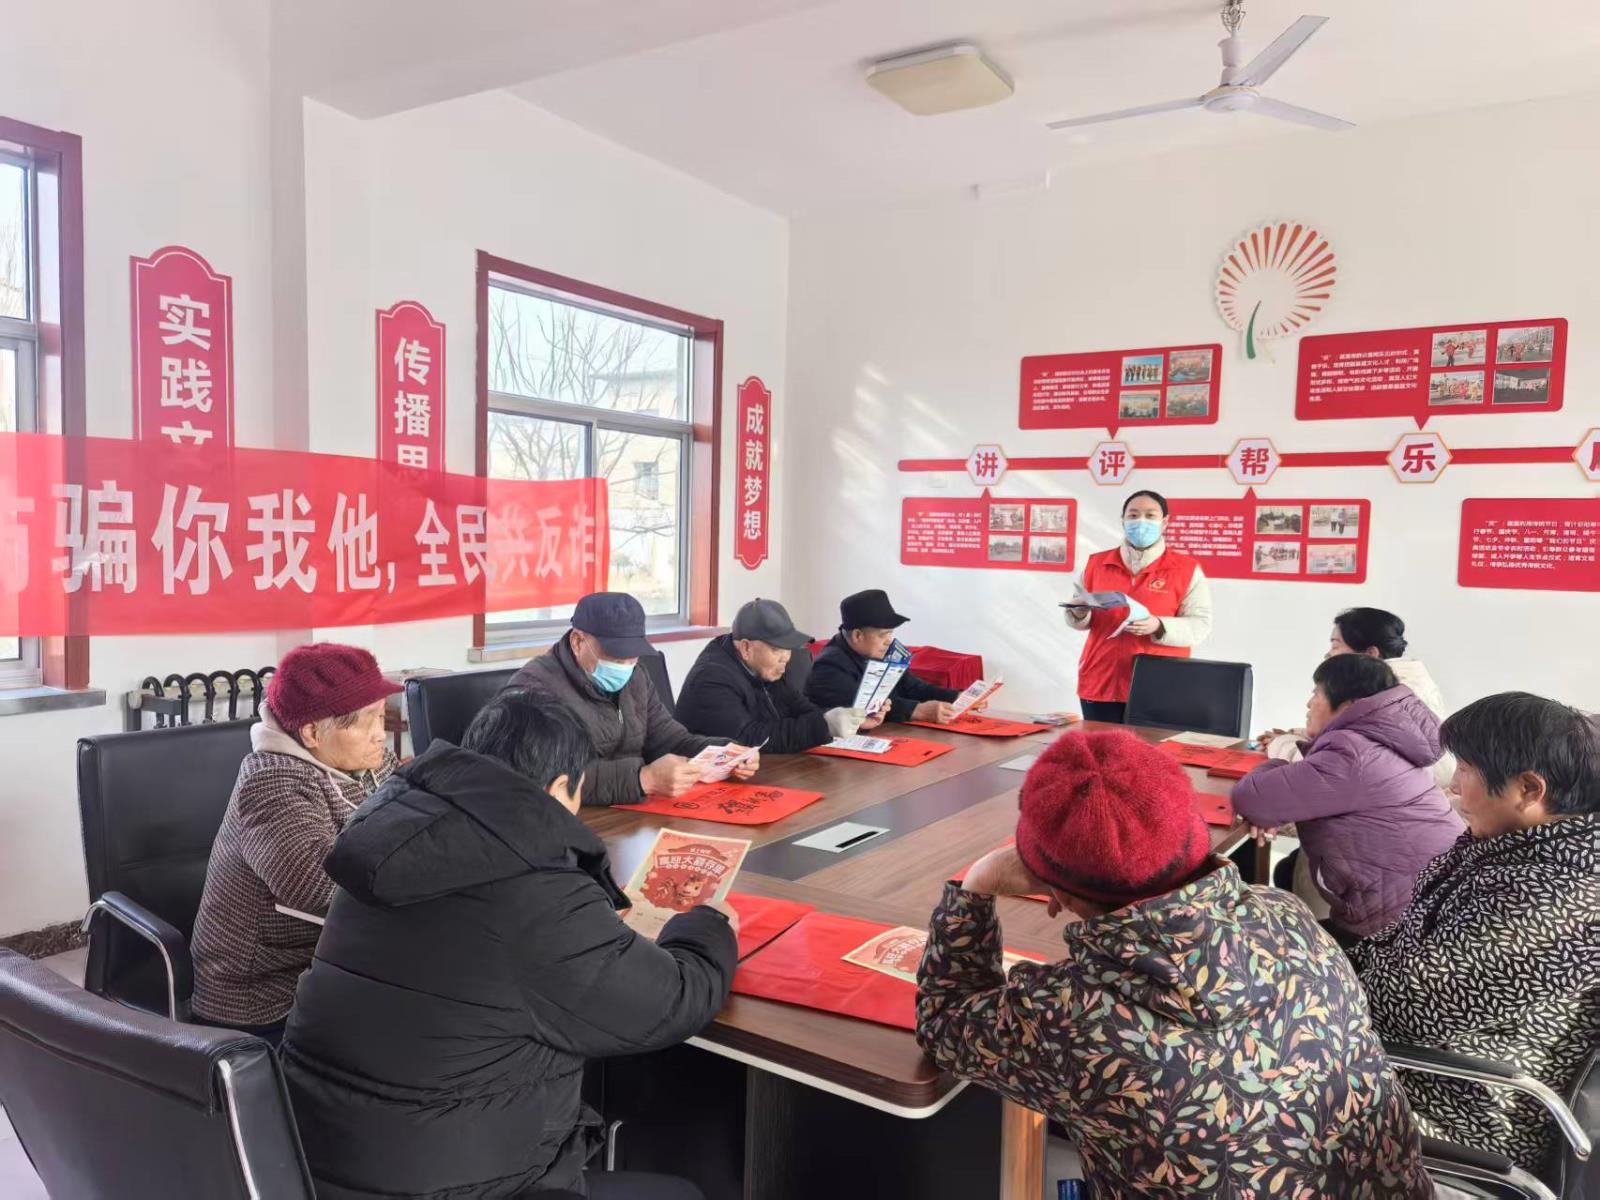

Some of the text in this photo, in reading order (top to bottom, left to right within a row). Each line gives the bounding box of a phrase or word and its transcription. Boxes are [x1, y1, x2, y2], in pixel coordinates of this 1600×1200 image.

[743, 403, 765, 541] 成就梦想
[975, 442, 1437, 478] 讲 评 帮 乐
